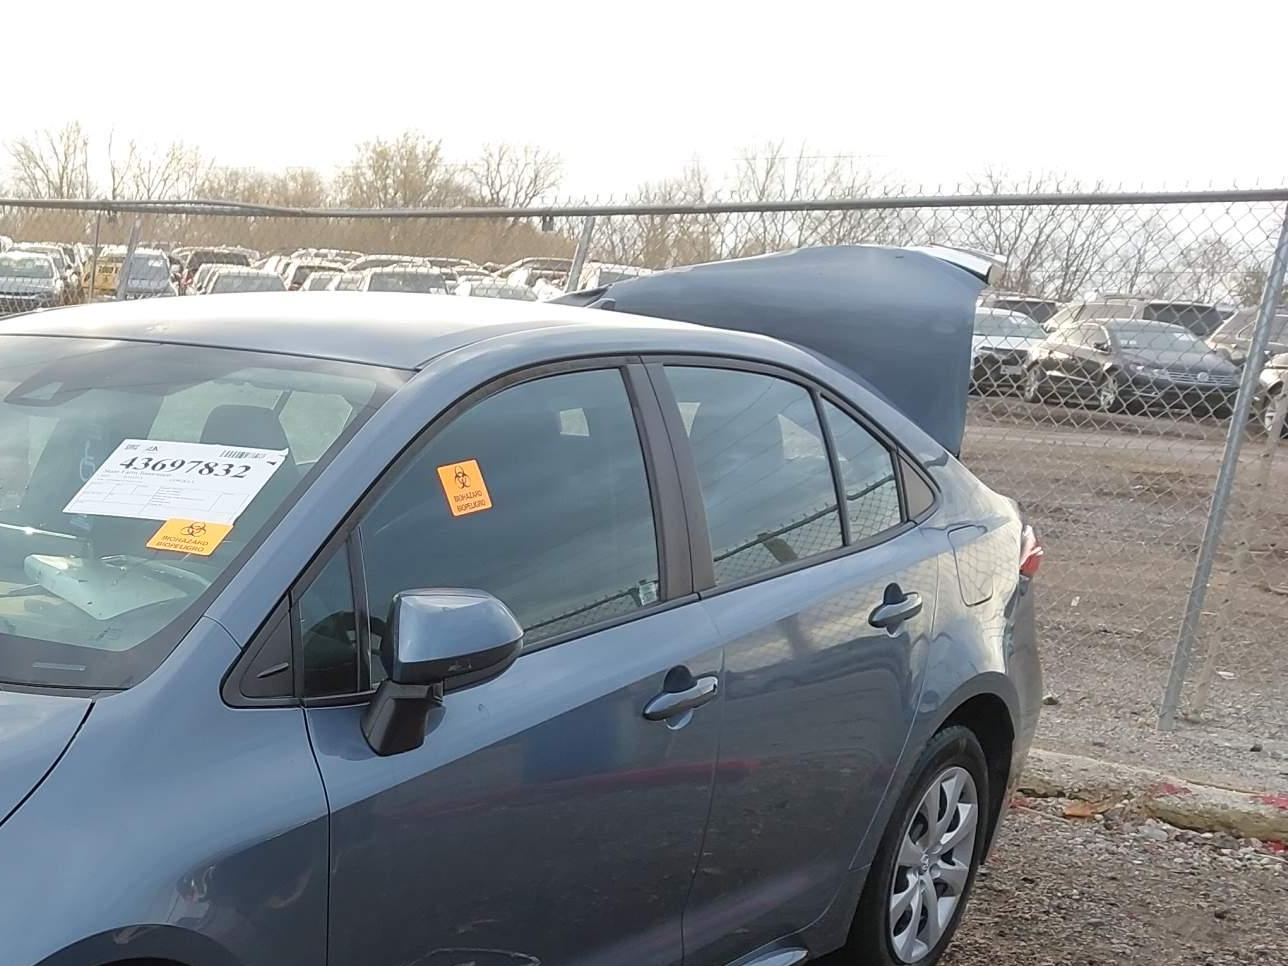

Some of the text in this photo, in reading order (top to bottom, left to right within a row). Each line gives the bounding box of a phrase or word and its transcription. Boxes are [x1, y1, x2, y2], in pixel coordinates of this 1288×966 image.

[119, 456, 251, 479] 43697832
[162, 535, 209, 546] BIOHAZARD
[156, 541, 205, 552] BIOPELIGRO
